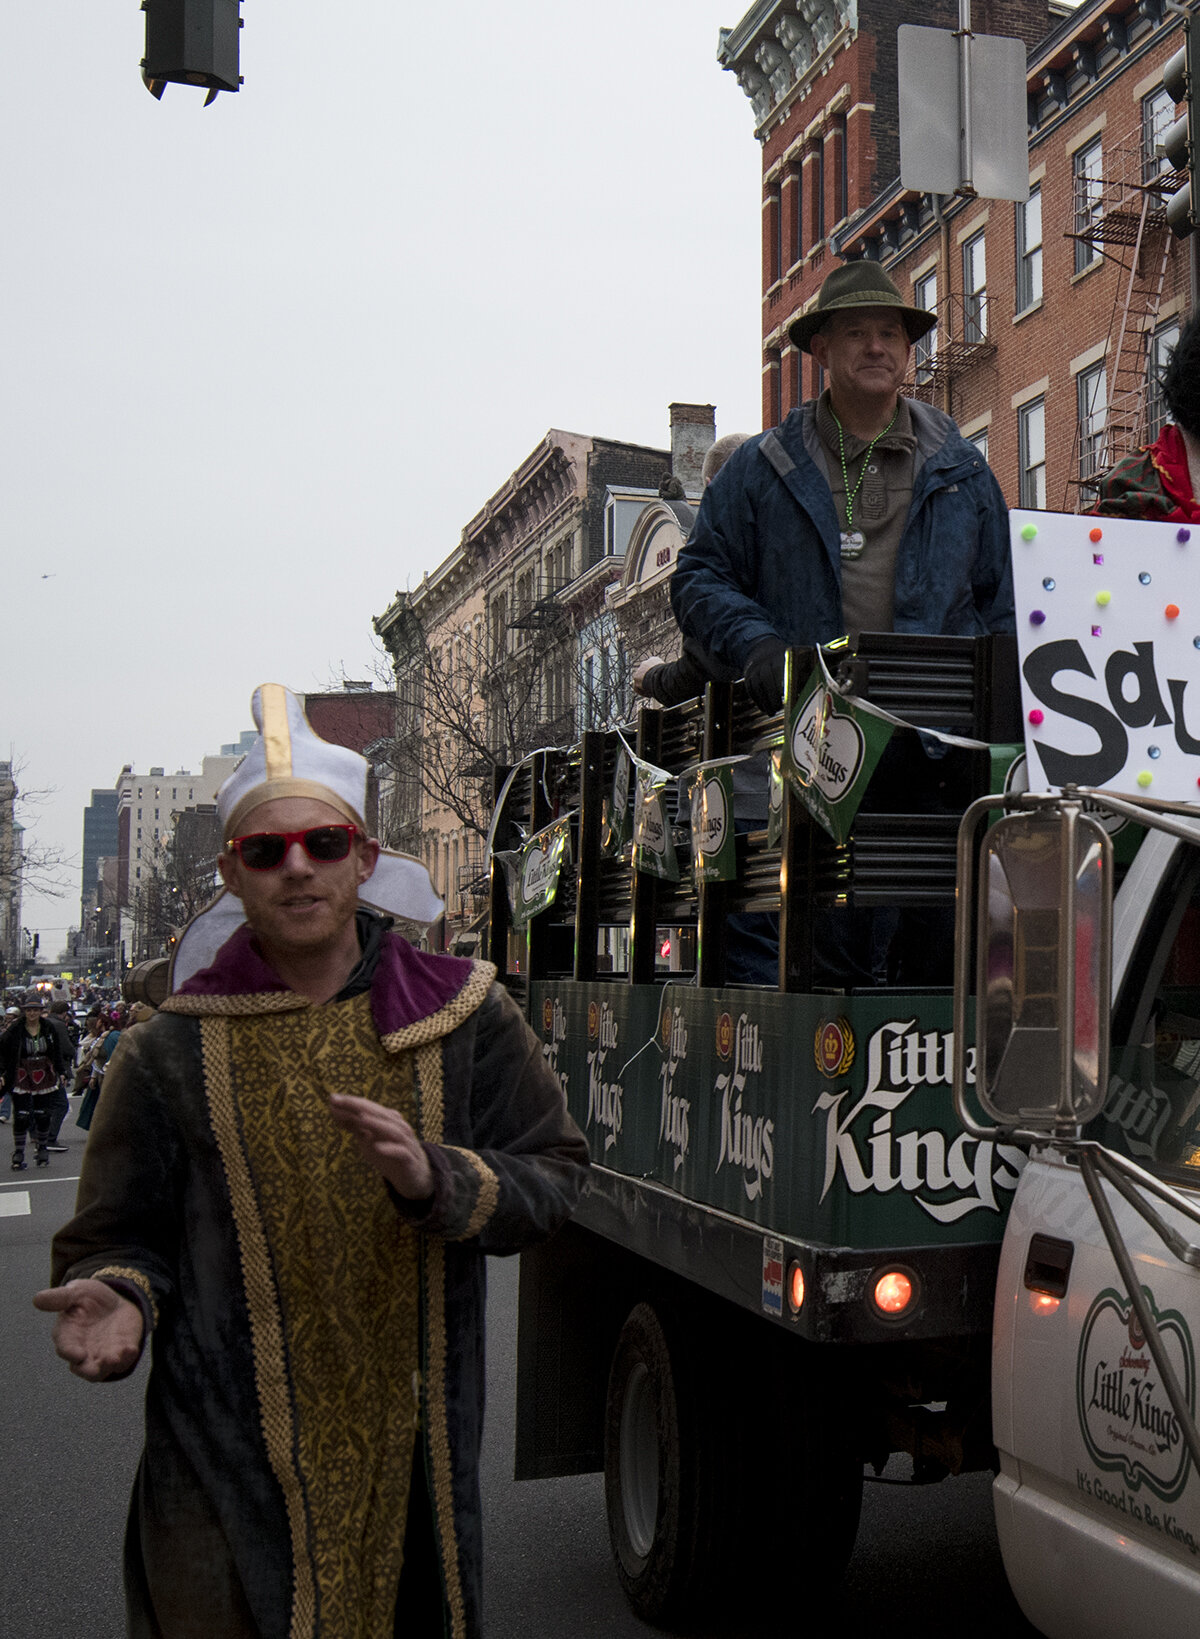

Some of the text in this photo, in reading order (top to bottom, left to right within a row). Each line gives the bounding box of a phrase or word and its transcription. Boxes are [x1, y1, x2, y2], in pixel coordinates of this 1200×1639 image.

[599, 1001, 619, 1054] Little
[733, 1012, 763, 1082] Little
[586, 1050, 624, 1151] Kings
[714, 1072, 775, 1201] Kings
[811, 1091, 1029, 1223] Kings
[1087, 1360, 1131, 1421] Little
[1128, 1377, 1180, 1453] Kings
[1076, 1469, 1092, 1496] It's
[1093, 1477, 1127, 1513] Good
[1127, 1495, 1143, 1521] To
[1144, 1503, 1162, 1532] Be
